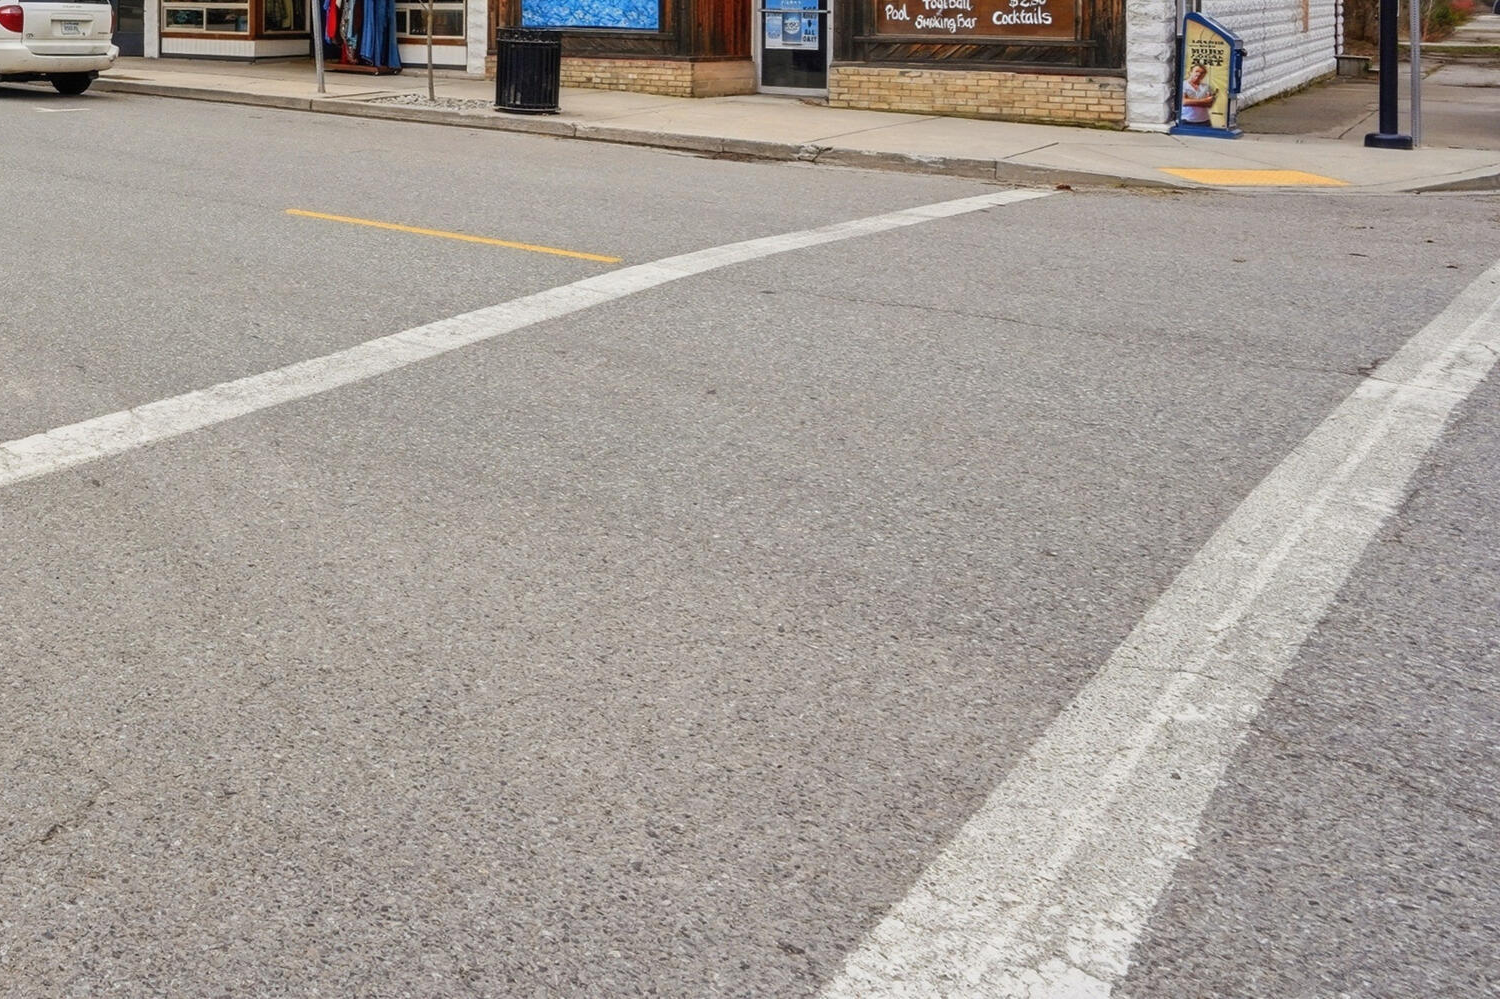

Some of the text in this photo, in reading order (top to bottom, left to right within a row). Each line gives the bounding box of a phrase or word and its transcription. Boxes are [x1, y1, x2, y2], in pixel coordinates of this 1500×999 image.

[885, 4, 911, 21] Pool
[957, 13, 977, 29] Bar
[992, 5, 1053, 26] Cocktails
